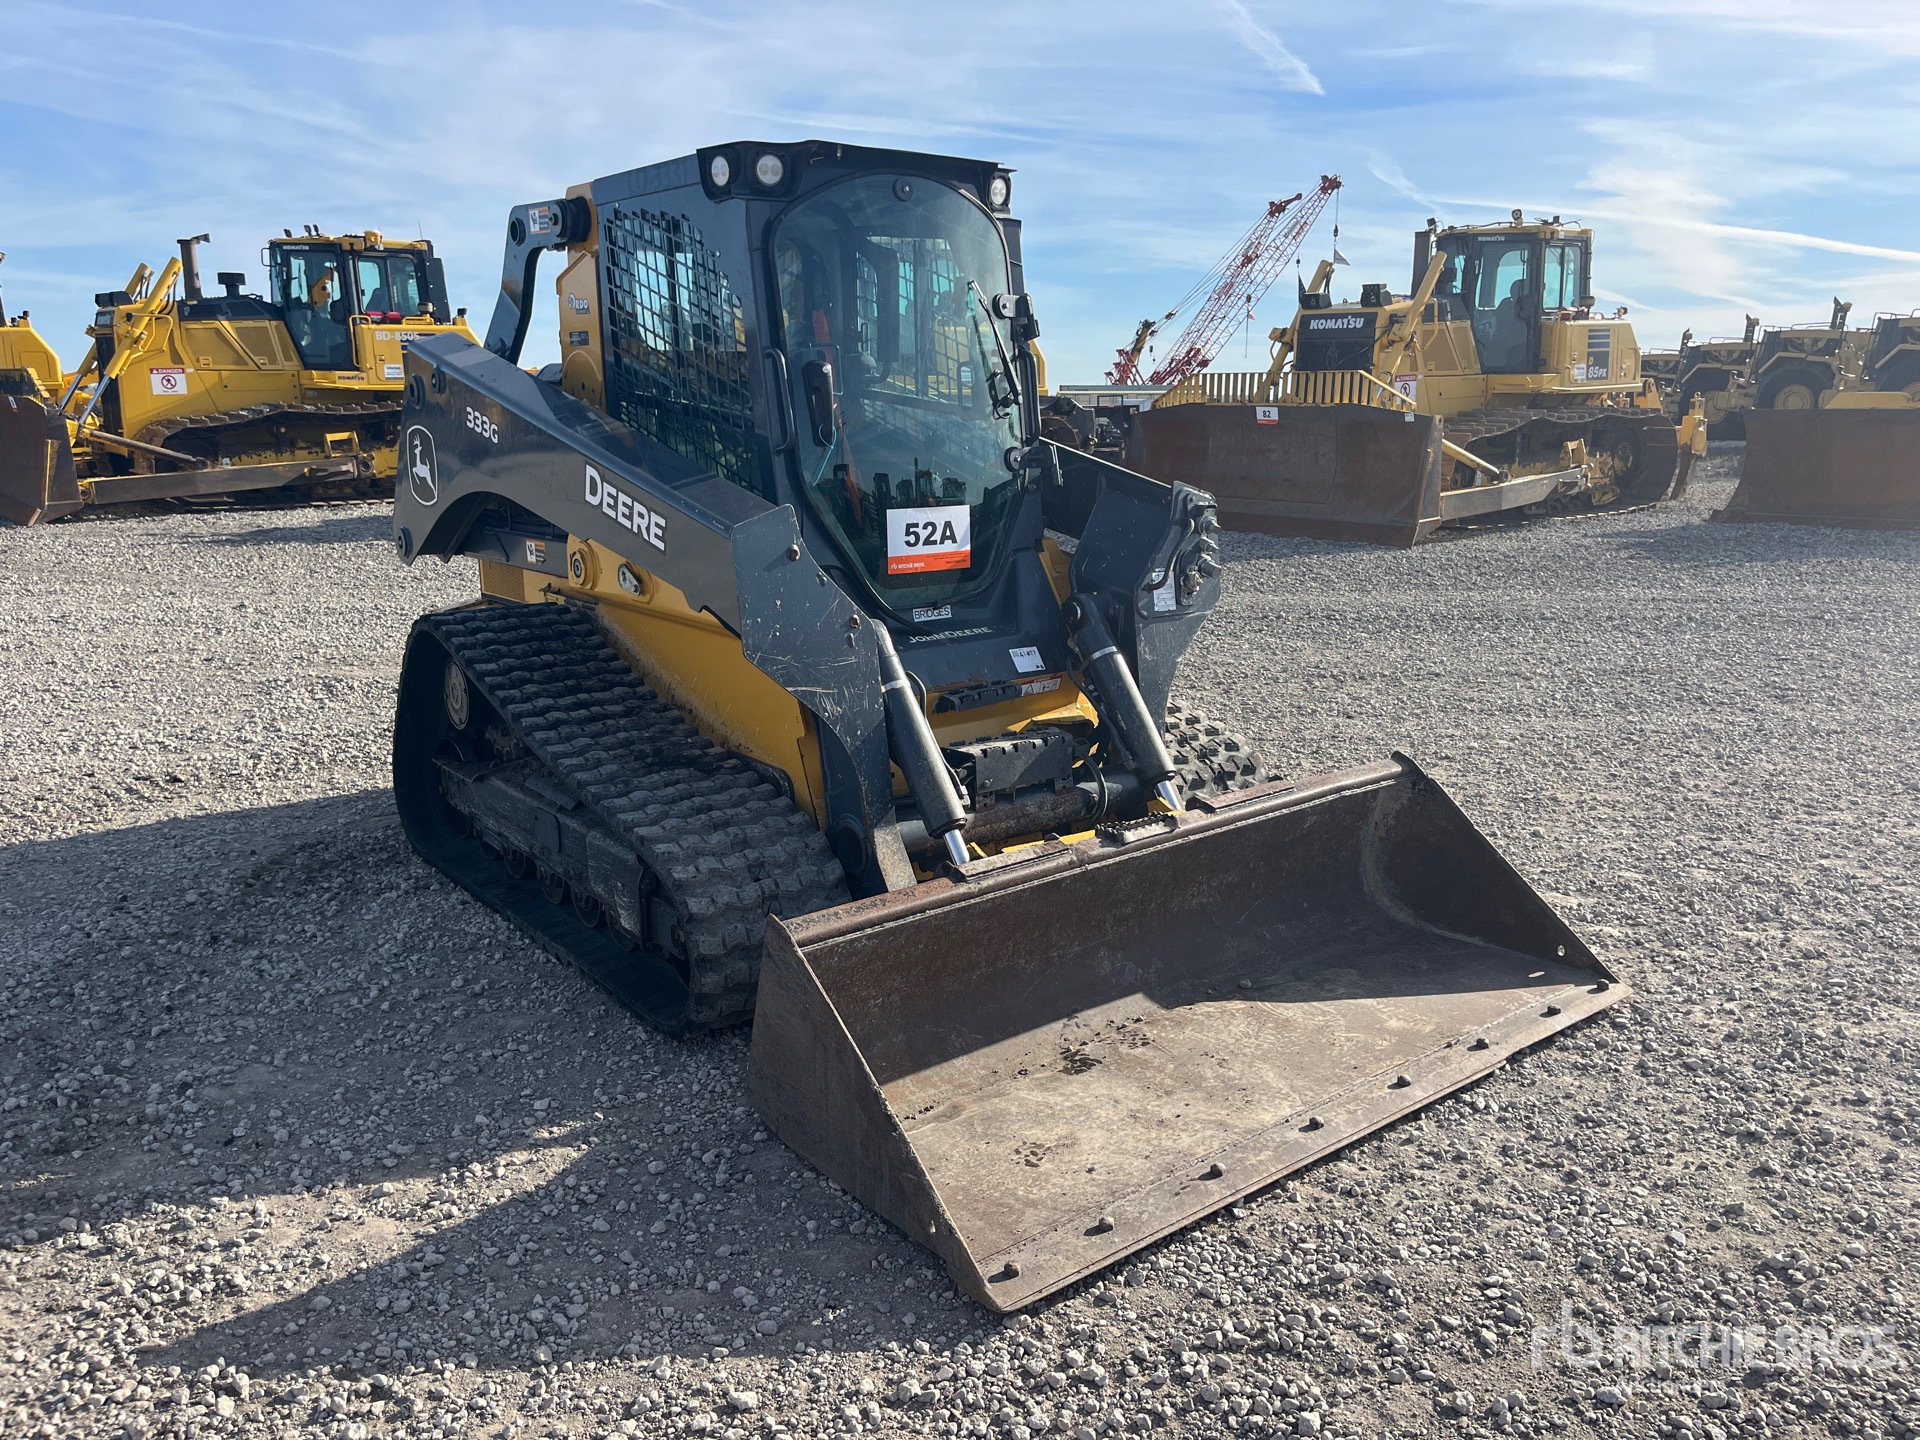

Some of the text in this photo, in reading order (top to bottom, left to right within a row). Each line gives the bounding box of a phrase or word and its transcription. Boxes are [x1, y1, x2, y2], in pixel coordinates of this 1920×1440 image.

[1309, 315, 1365, 330] KOMATSU
[1262, 410, 1272, 419] 82
[466, 406, 499, 444] 333G
[585, 464, 666, 551] DEERE
[904, 520, 958, 547] 52A
[914, 606, 951, 620] BRIDGES
[909, 626, 993, 643] JOHN DEERE
